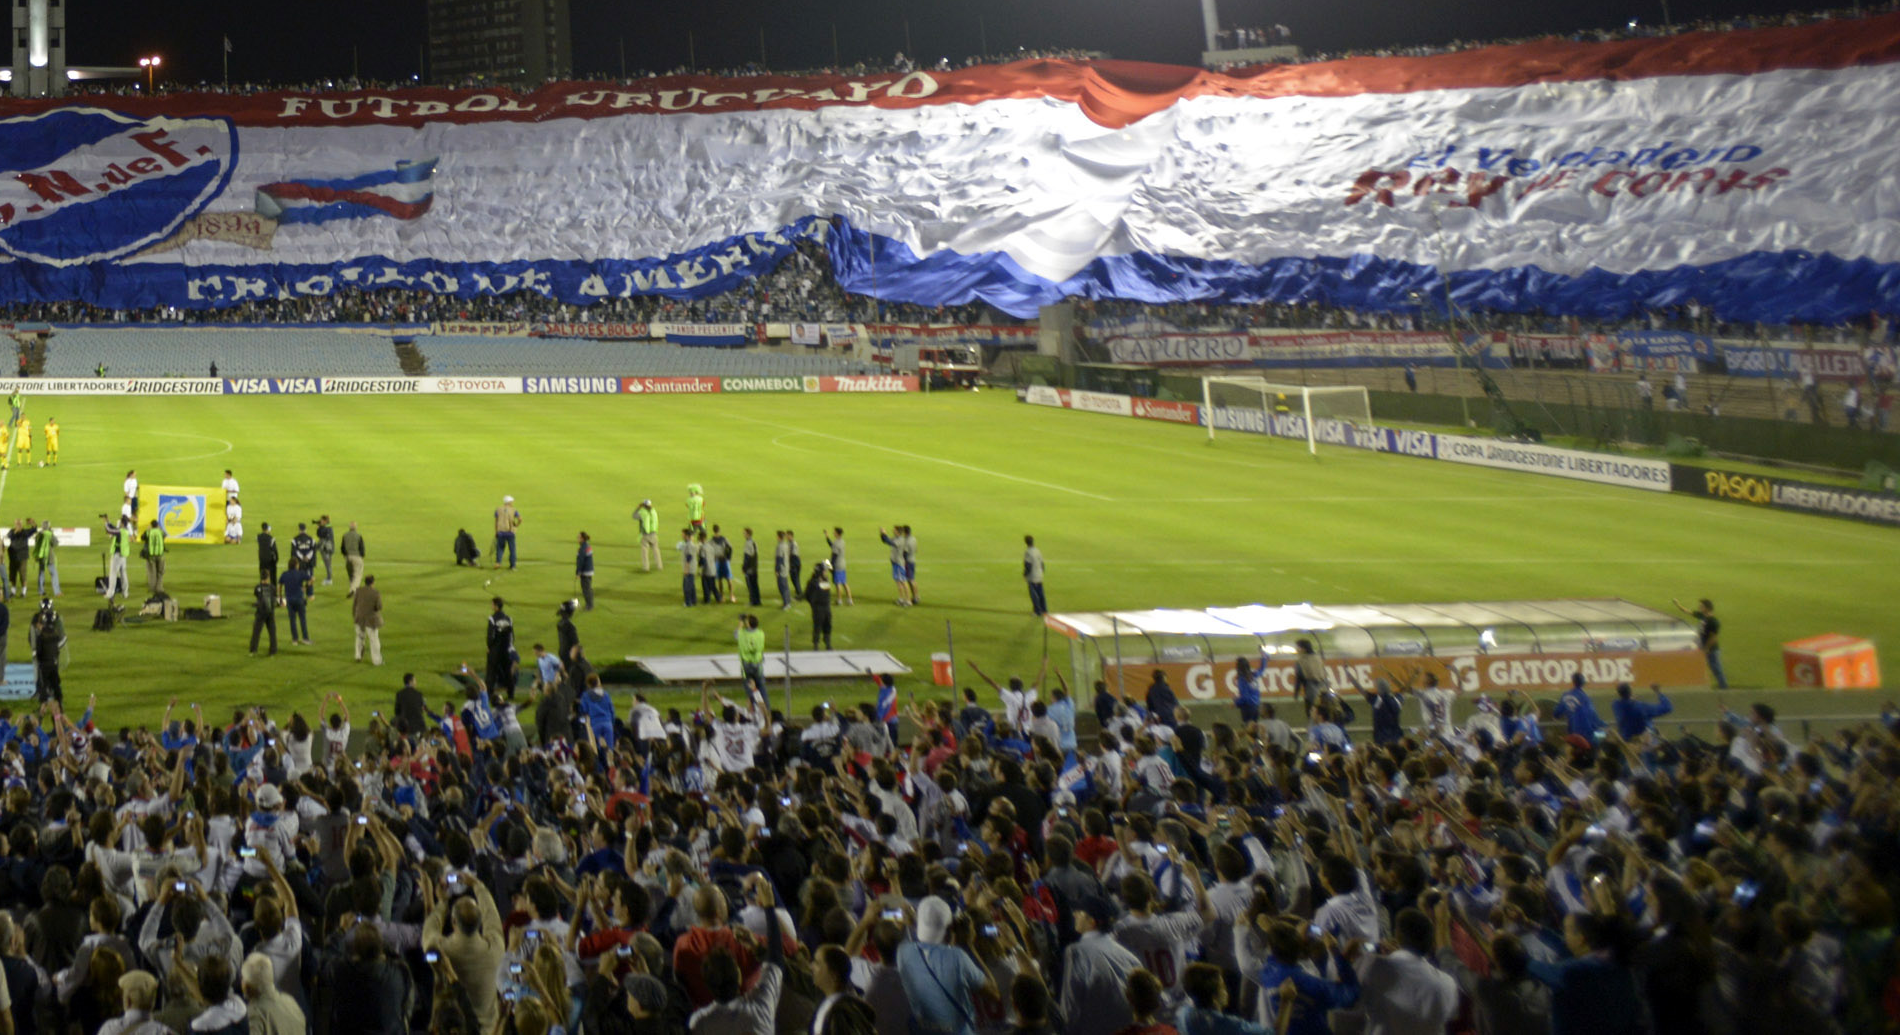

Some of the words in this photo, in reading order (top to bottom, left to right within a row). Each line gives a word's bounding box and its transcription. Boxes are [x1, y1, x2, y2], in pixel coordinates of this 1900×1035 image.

[279, 94, 538, 118] FUTBOL
[545, 323, 586, 337] SALTO
[588, 323, 604, 337] ES
[607, 323, 647, 337] BOLSO
[1112, 336, 1244, 362] CAPURRO
[47, 381, 125, 392] LIBERTADORES
[126, 379, 222, 393] BRIDGESTONE
[228, 378, 271, 394] VISA
[274, 378, 317, 394] VISA
[324, 379, 420, 393] BRIDGESTONE
[457, 380, 506, 390] TOYOTA
[526, 377, 618, 394] SAMSUNG
[645, 377, 714, 393] Santander
[723, 377, 801, 391] CONMEBOL
[1393, 429, 1434, 458] VISA
[1453, 442, 1484, 459] COPA
[1567, 456, 1669, 484] LIBERTADORES
[1704, 470, 1771, 504] PASION
[1224, 664, 1376, 695] GTOADE
[1488, 658, 1635, 687] GATORADE
